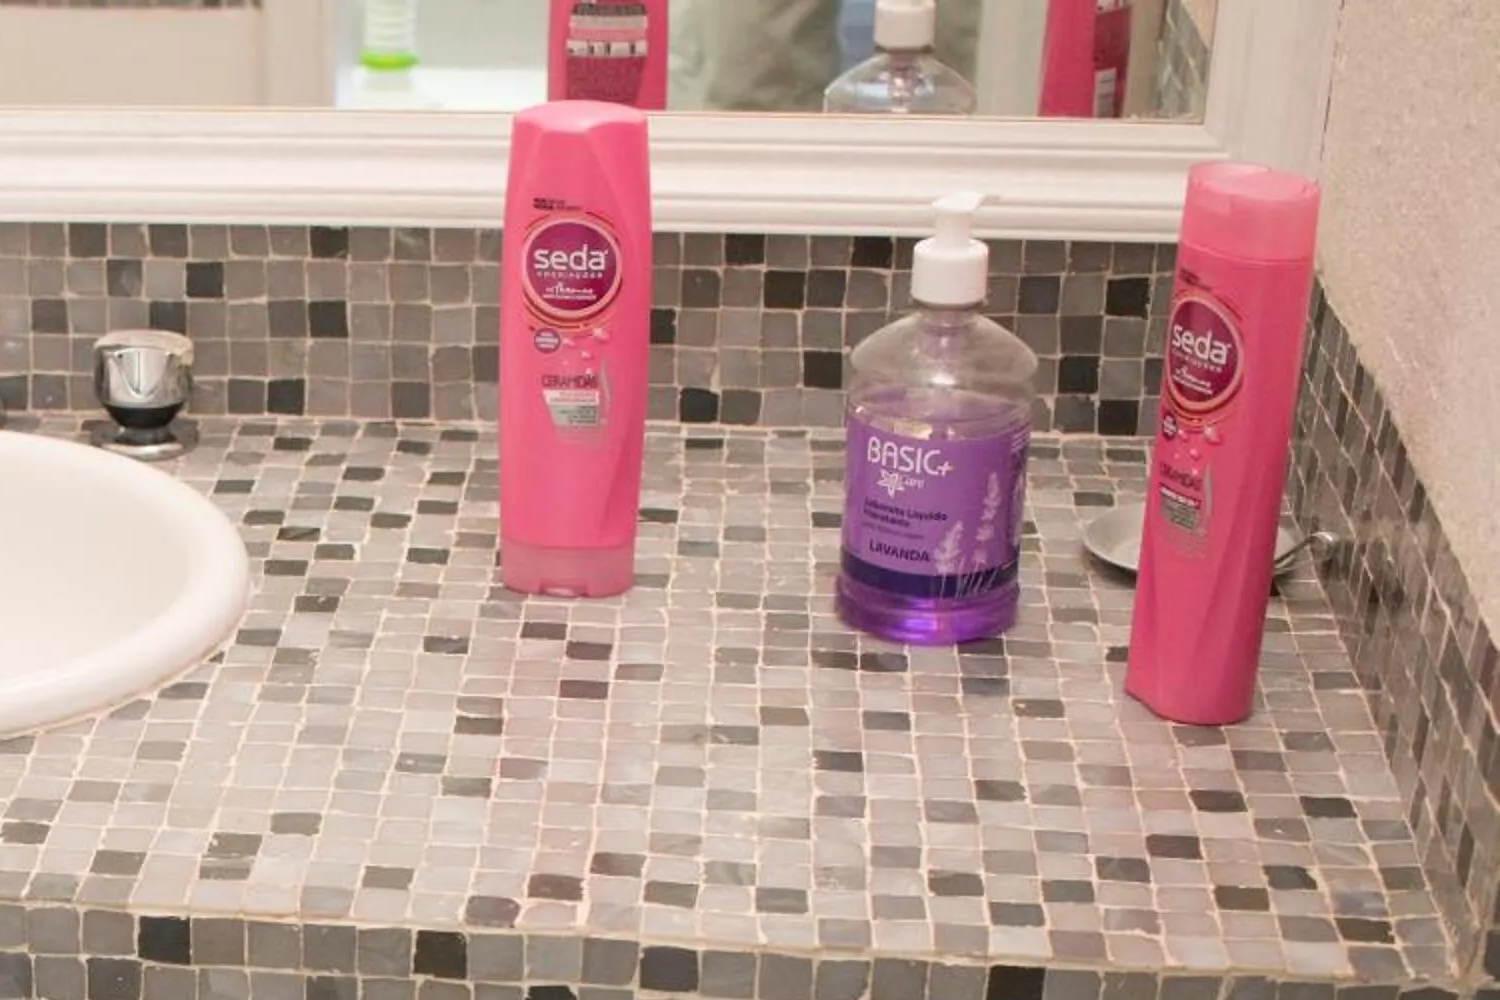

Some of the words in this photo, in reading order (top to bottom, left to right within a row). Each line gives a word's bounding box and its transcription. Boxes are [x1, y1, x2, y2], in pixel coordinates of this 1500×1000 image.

[533, 243, 606, 271] seda
[1171, 324, 1228, 365] seda
[867, 436, 953, 477] BASIC+
[869, 538, 930, 562] LAVANDA
